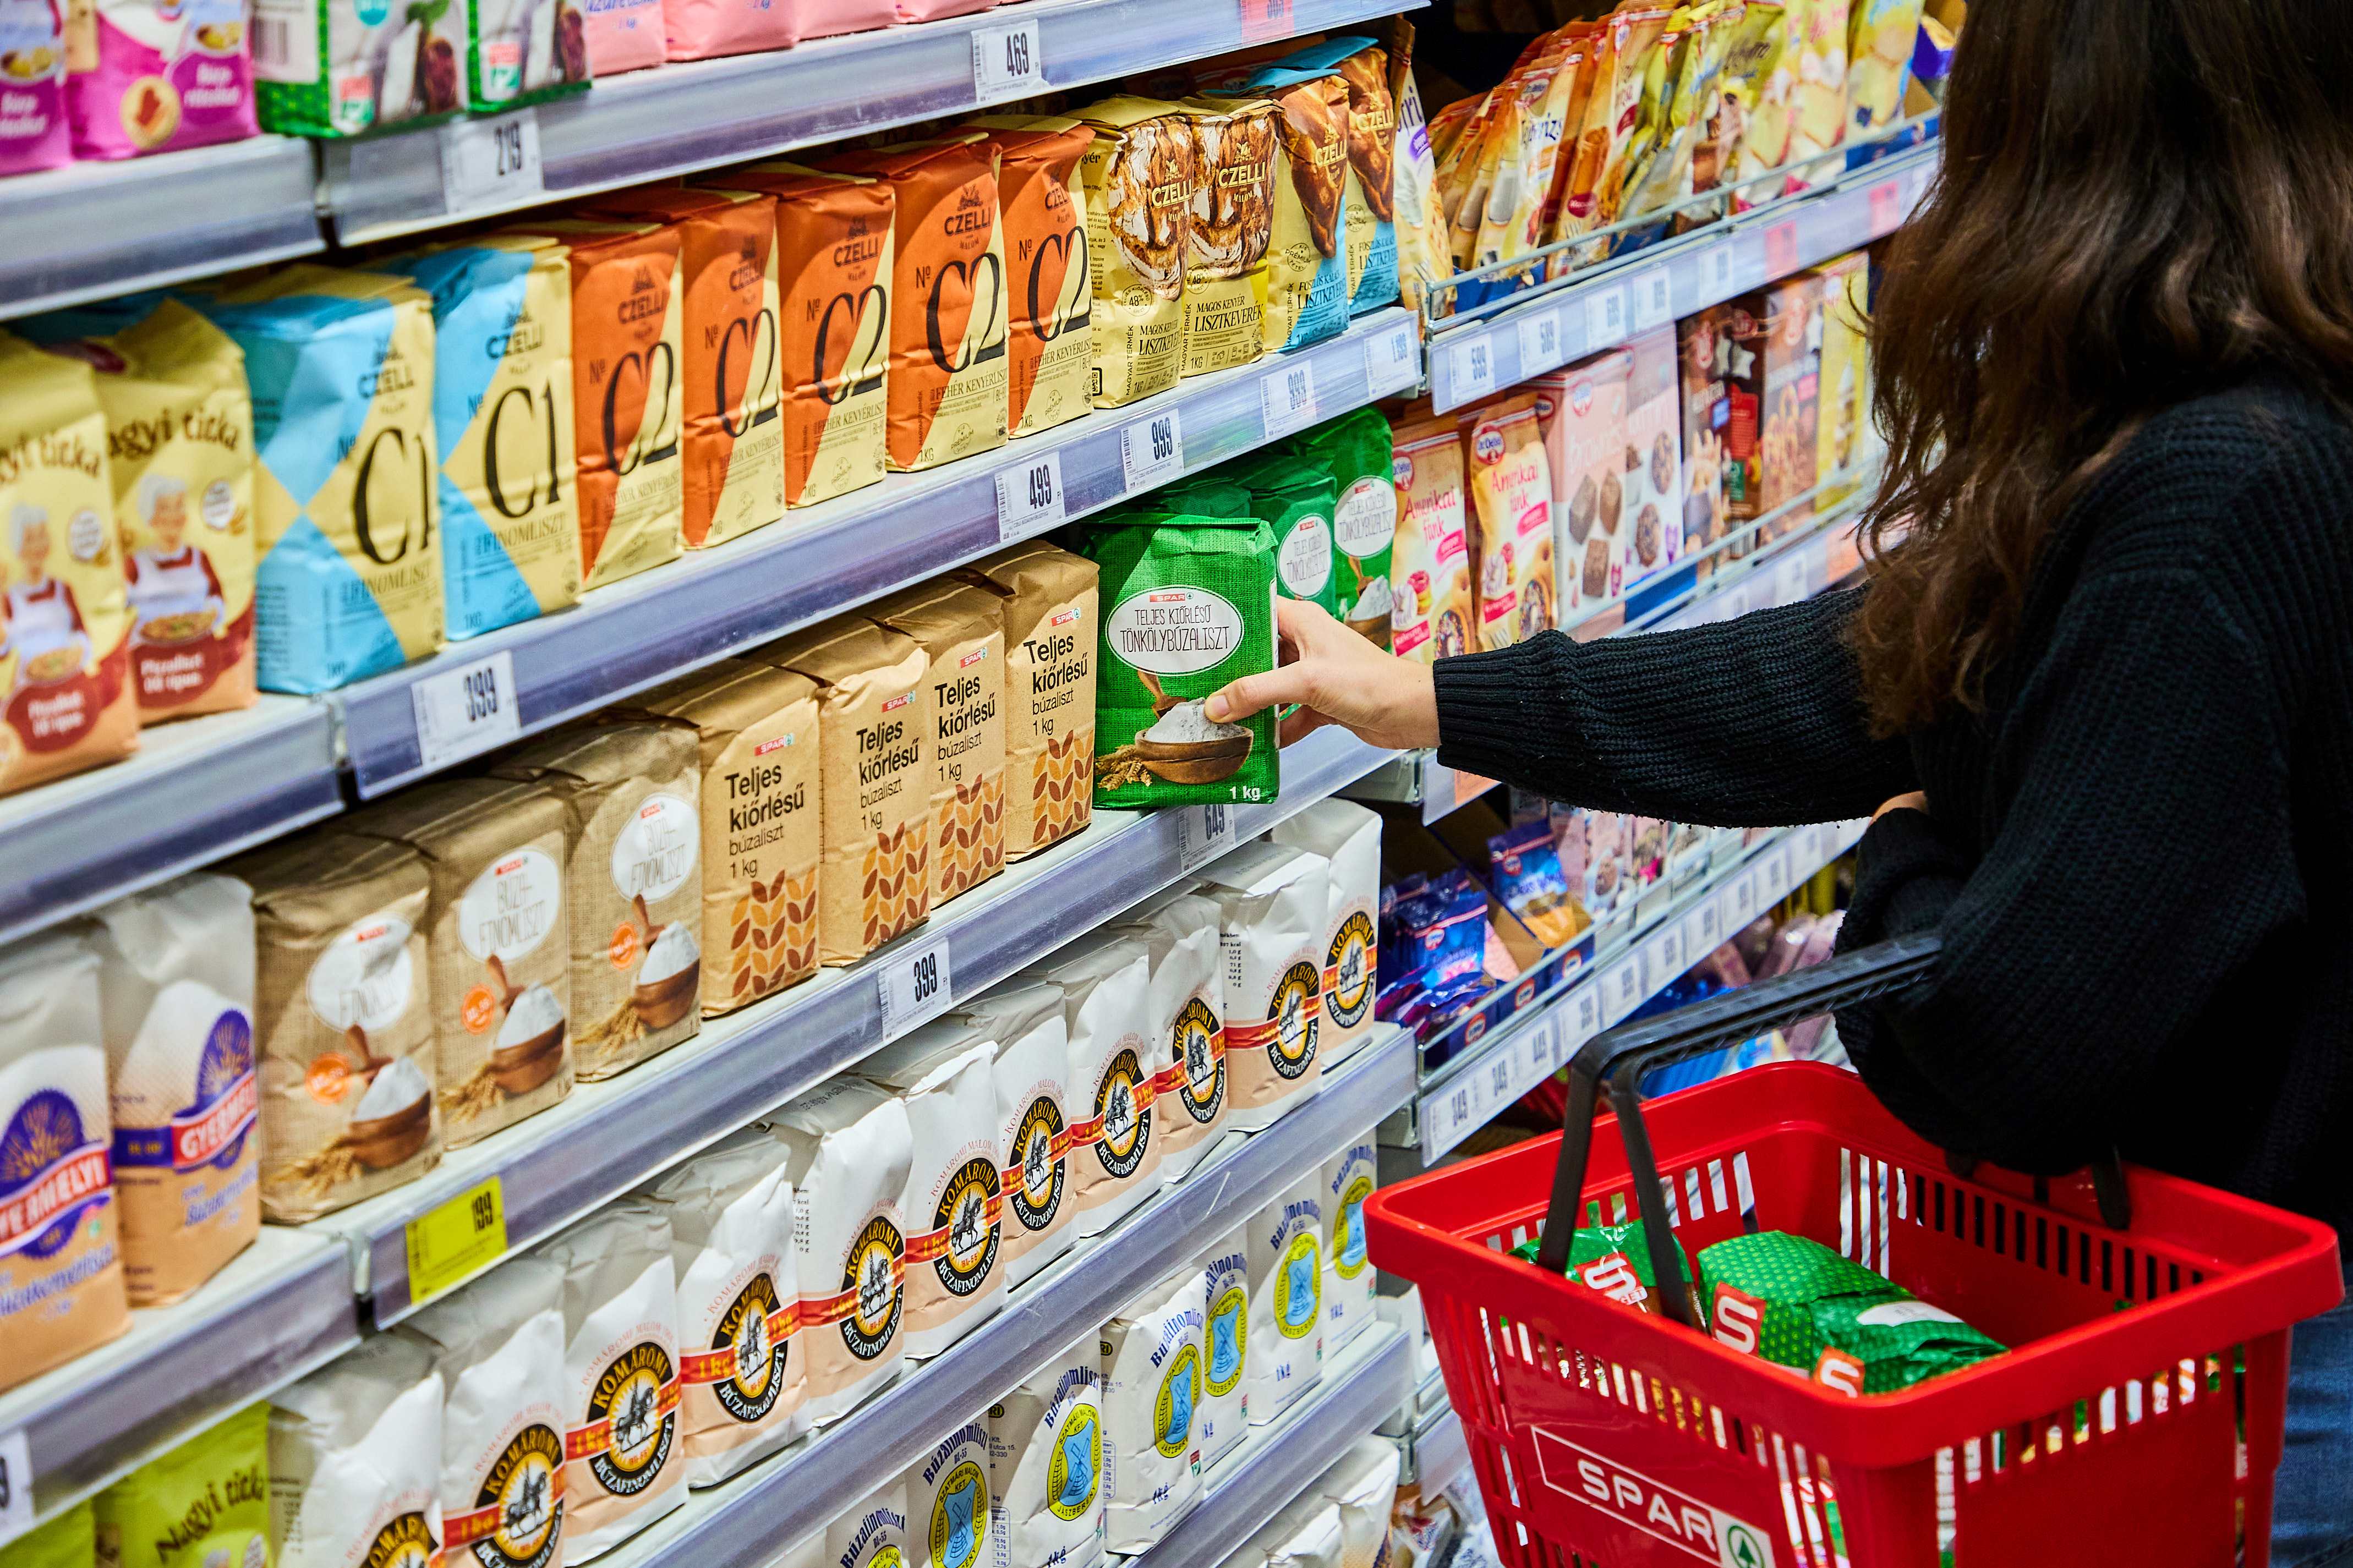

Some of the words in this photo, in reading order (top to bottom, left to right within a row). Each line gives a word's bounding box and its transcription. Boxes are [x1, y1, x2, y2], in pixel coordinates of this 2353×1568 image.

[1006, 33, 1029, 77] 469
[1356, 110, 1394, 133] CZELLI
[1315, 139, 1347, 167] CZELLI
[1218, 162, 1266, 189] CZELLI
[1151, 179, 1192, 209] CZELLI
[1233, 190, 1253, 203] MALOM
[944, 207, 991, 235] CZELLI
[834, 237, 879, 267] CZELLI
[1285, 249, 1311, 264] PRÉMIUM
[1028, 226, 1091, 342] C2
[926, 252, 1006, 374] C2
[1129, 294, 1144, 306] 48%
[1197, 299, 1221, 312] MAGOS
[1222, 293, 1245, 310] KENYÉR
[1140, 321, 1163, 335] MAGOS
[1195, 301, 1264, 332] LISZTKEVERÉK
[814, 284, 887, 405] C2
[717, 308, 778, 437] C2
[1191, 357, 1203, 369] 1KG
[602, 342, 677, 476] C2
[1152, 417, 1173, 460] 999
[920, 448, 934, 462] 1KG
[1030, 464, 1052, 509] 499
[1491, 459, 1539, 493] Amerikai
[1402, 484, 1457, 522] Amerikai
[1056, 611, 1074, 624] SPAR
[1135, 609, 1165, 626] TELJES
[1169, 606, 1211, 623] KIŐRLÉSŰ
[1023, 633, 1074, 664] Teljes
[1120, 626, 1230, 653] TÖNKÖLYBÚZALISZT
[964, 652, 981, 665] SPAR
[1032, 652, 1088, 694] kiőrlésű
[463, 667, 497, 723] 399
[887, 696, 908, 710] SPAR
[935, 675, 980, 708] Teljes
[1033, 687, 1074, 715] búzaliszt
[938, 692, 995, 738] kiőrlésű
[1033, 721, 1038, 736] 1
[1041, 717, 1054, 735] kg
[760, 738, 785, 754] SPAR
[856, 721, 903, 753] Teljes
[938, 731, 982, 760] búzaliszt
[858, 738, 920, 786] kiőrlésű
[939, 766, 944, 781] 1
[948, 763, 962, 781] kg
[725, 765, 781, 799] Teljes
[860, 777, 902, 808] búzaliszt
[1230, 787, 1236, 799] 1
[1243, 786, 1260, 801] kg
[730, 783, 804, 832] kiőrlésű
[861, 816, 866, 831] 1
[869, 812, 882, 829] kg
[1205, 804, 1224, 840] 649
[730, 825, 785, 856] búzaliszt
[731, 864, 736, 878] 1
[741, 859, 757, 878] kg
[1331, 914, 1373, 957] KOMÁROMI
[914, 952, 937, 1002] 399
[1273, 965, 1318, 1009] KOMÁROMI
[1097, 1054, 1137, 1104] KOMÁROMI
[1138, 1092, 1143, 1106] 1
[1144, 1084, 1154, 1104] kg
[1016, 1101, 1059, 1153] KOMÁROMI
[1099, 1115, 1150, 1175] BÚZAFINOMLISZT
[939, 1163, 997, 1218] KOMÁROMI
[1016, 1164, 1063, 1227] BÚZAFINOMLISZT
[472, 1191, 494, 1235] 199
[847, 1222, 900, 1278] KOMÁROMI
[924, 1241, 928, 1256] 1
[939, 1228, 999, 1293] BÚZAFINOMLISZT
[593, 1347, 669, 1410] KOMÁROMI
[699, 1361, 705, 1378] 1
[710, 1355, 731, 1377] kg
[939, 1470, 964, 1503] SZATMÁRI
[1578, 1458, 1717, 1553] SPAR
